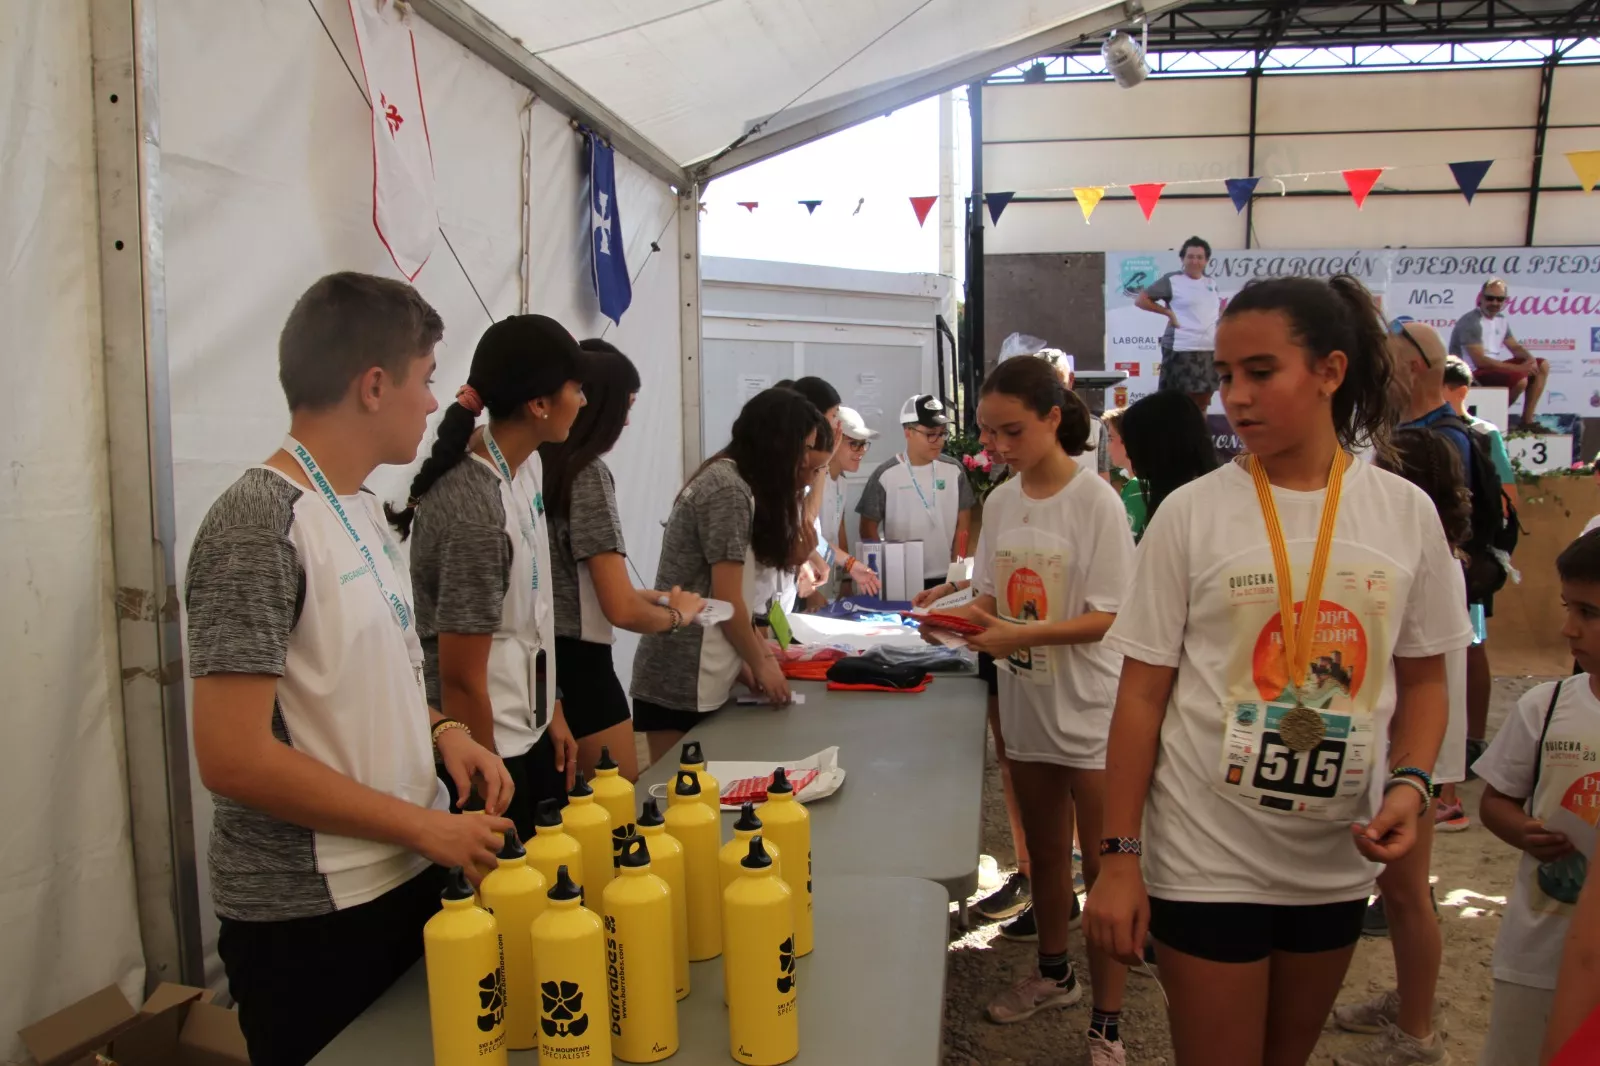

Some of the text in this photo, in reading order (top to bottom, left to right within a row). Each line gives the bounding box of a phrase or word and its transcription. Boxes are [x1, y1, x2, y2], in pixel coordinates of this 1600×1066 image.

[1201, 251, 1379, 279] ONTEARAGÓN
[1396, 255, 1497, 275] PIEDRA
[1503, 255, 1521, 275] A
[1112, 336, 1157, 345] LABORAL
[1532, 442, 1548, 465] 3
[294, 445, 316, 472] TRAIL
[313, 471, 361, 543] MONTEARAGÓN
[1229, 573, 1274, 590] QUICENA
[1260, 743, 1341, 788] 515
[607, 937, 621, 1037] barrabes
[618, 943, 628, 1019] www.barrabes.com
[542, 1049, 590, 1060] SPECIALISTS
[555, 1045, 590, 1054] MOUNTAIN
